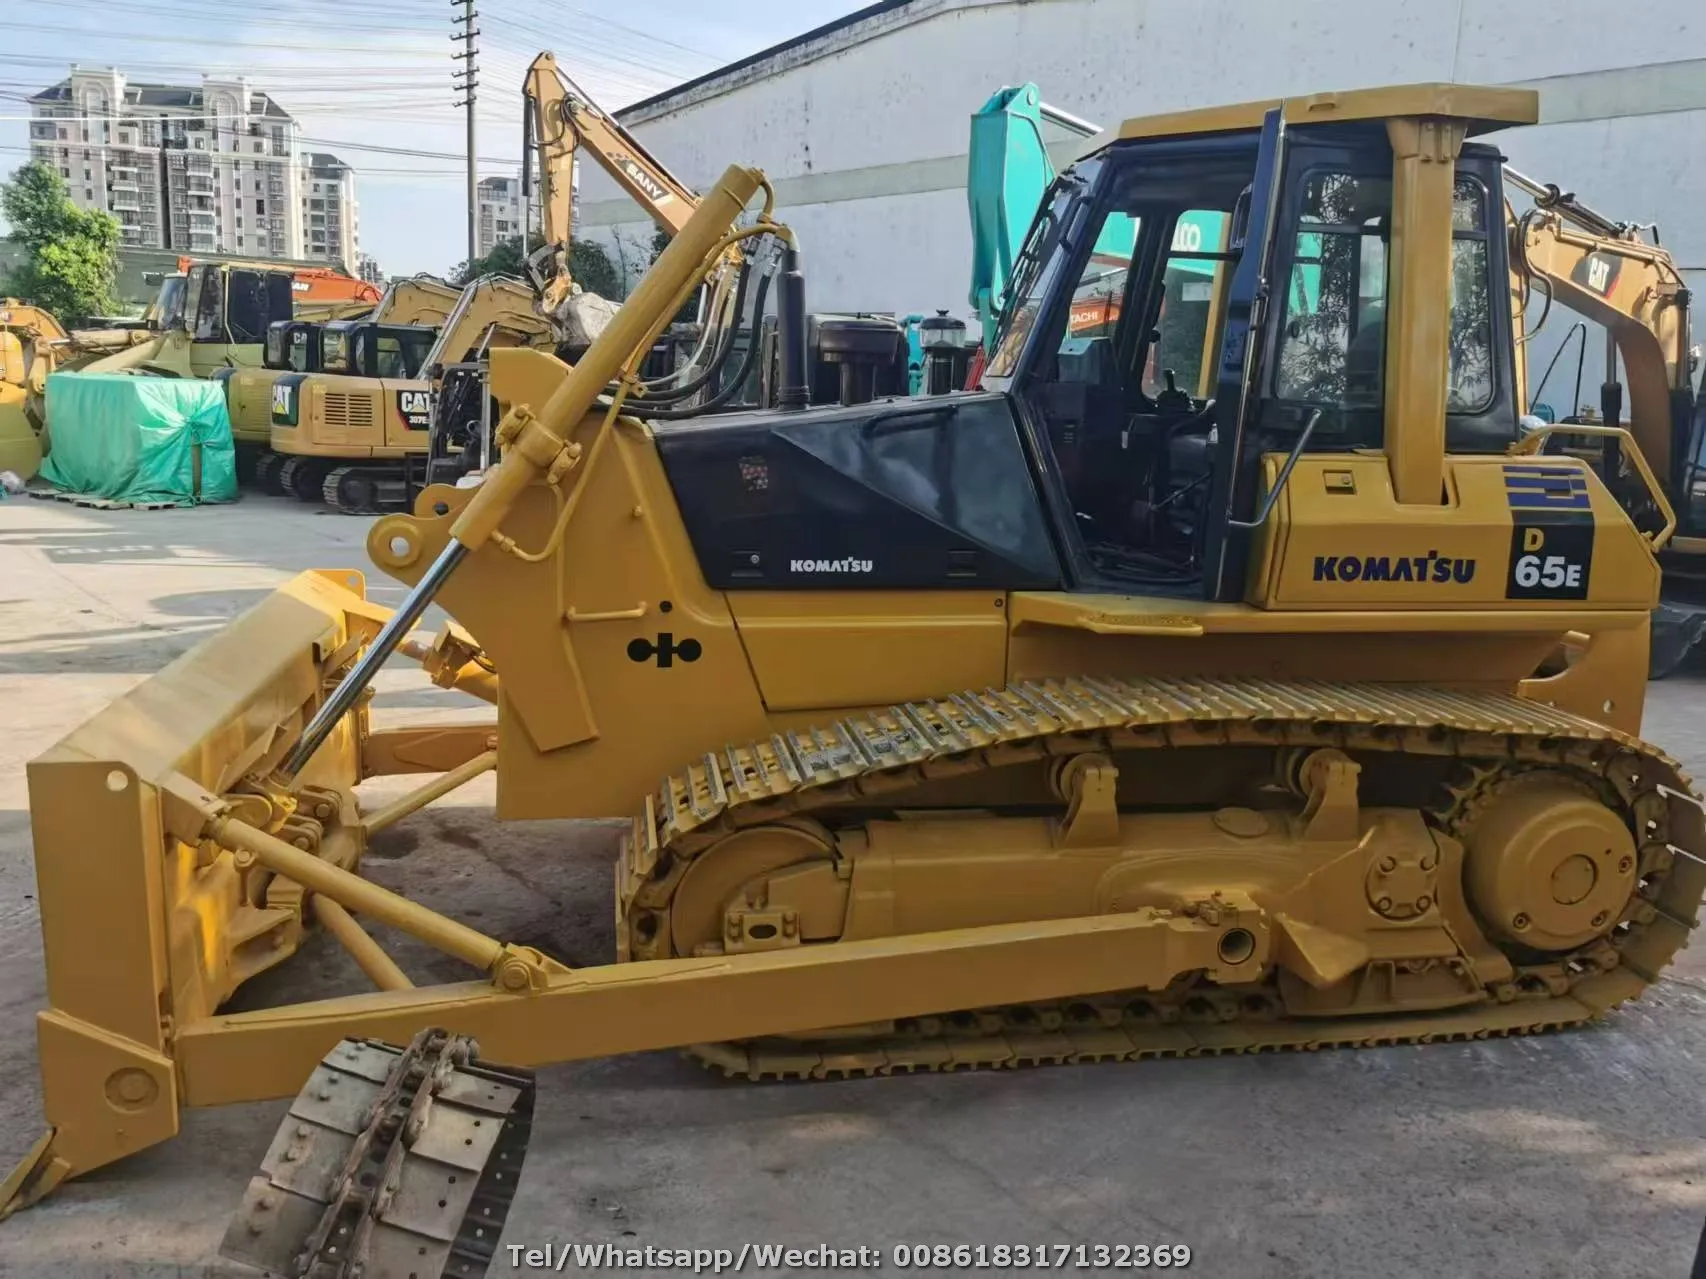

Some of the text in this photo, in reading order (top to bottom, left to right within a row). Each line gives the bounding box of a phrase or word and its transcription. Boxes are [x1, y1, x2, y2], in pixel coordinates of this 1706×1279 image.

[626, 162, 663, 198] SANY
[1588, 257, 1610, 292] CAT
[1523, 527, 1544, 551] D
[790, 556, 873, 573] KOMATSU
[1312, 550, 1475, 584] KOMATSU
[1515, 556, 1582, 588] 65E
